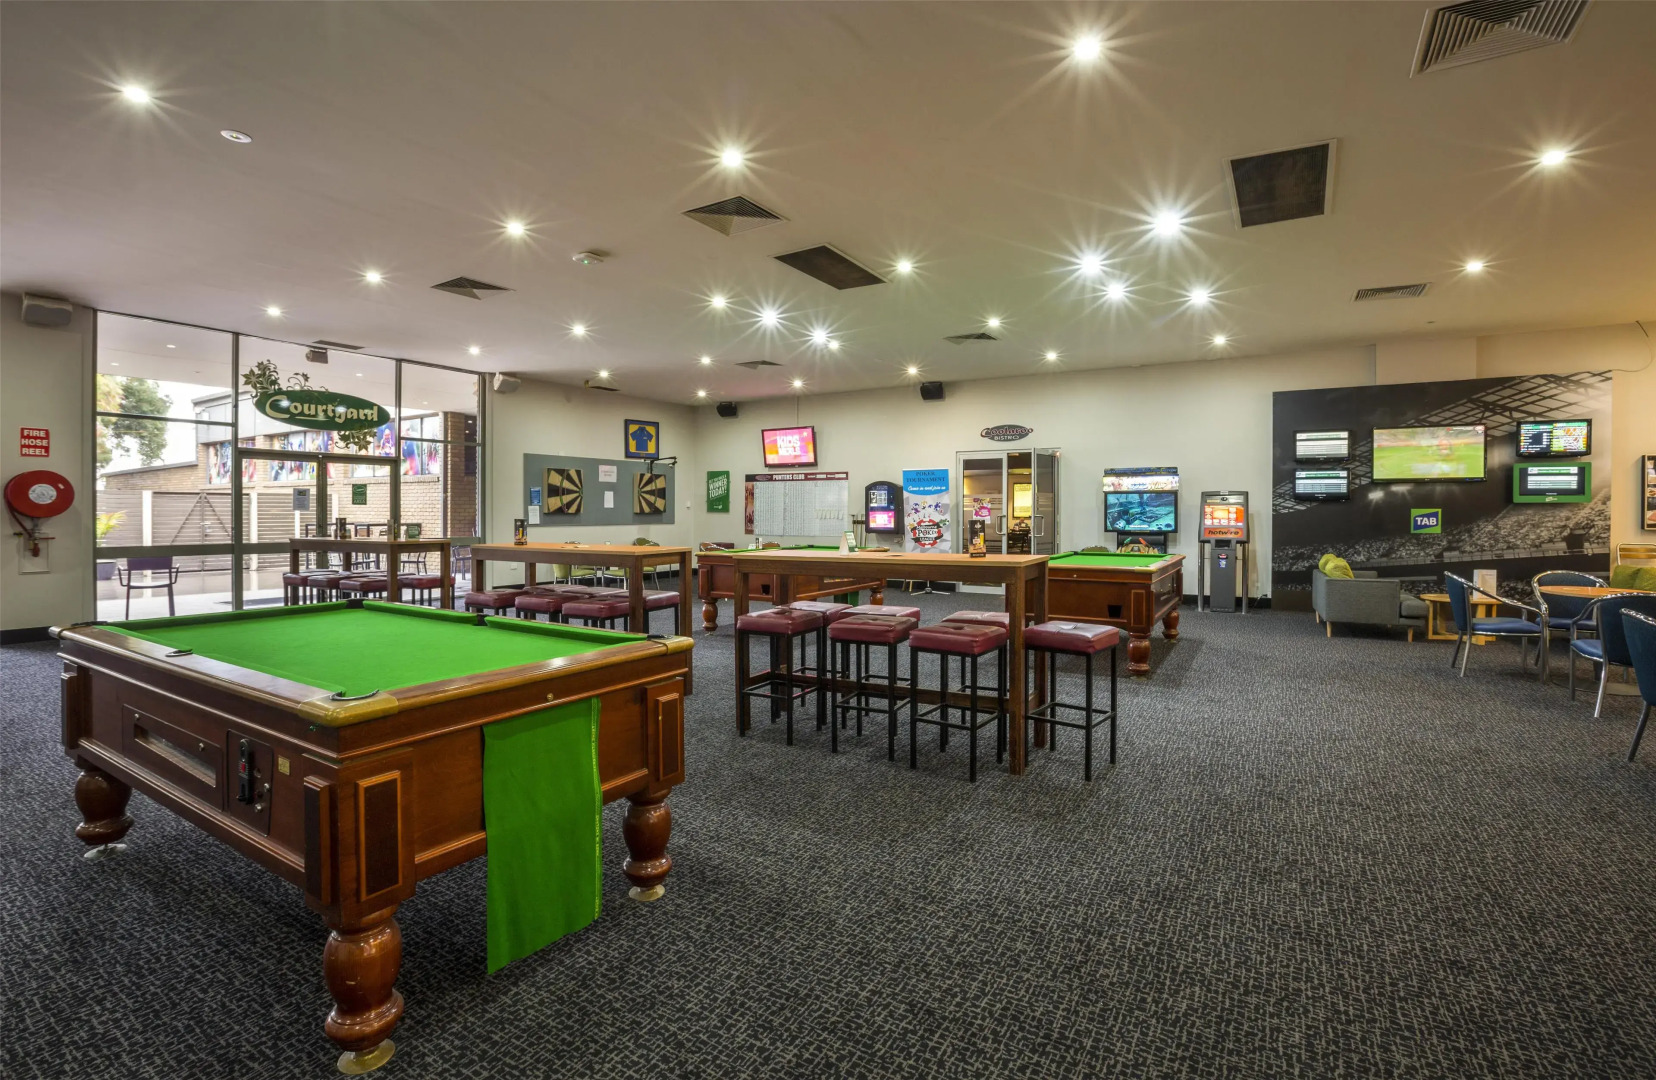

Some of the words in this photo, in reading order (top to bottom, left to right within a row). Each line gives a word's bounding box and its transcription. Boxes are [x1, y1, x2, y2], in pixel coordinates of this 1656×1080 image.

[265, 395, 378, 423] Courtyard
[23, 429, 47, 438] FIRE
[21, 438, 49, 446] HOSE
[777, 435, 800, 447] KIDS
[22, 447, 48, 456] REEL
[708, 478, 728, 491] WINNER
[708, 485, 728, 499] TODAY!
[1415, 516, 1437, 526] TAB
